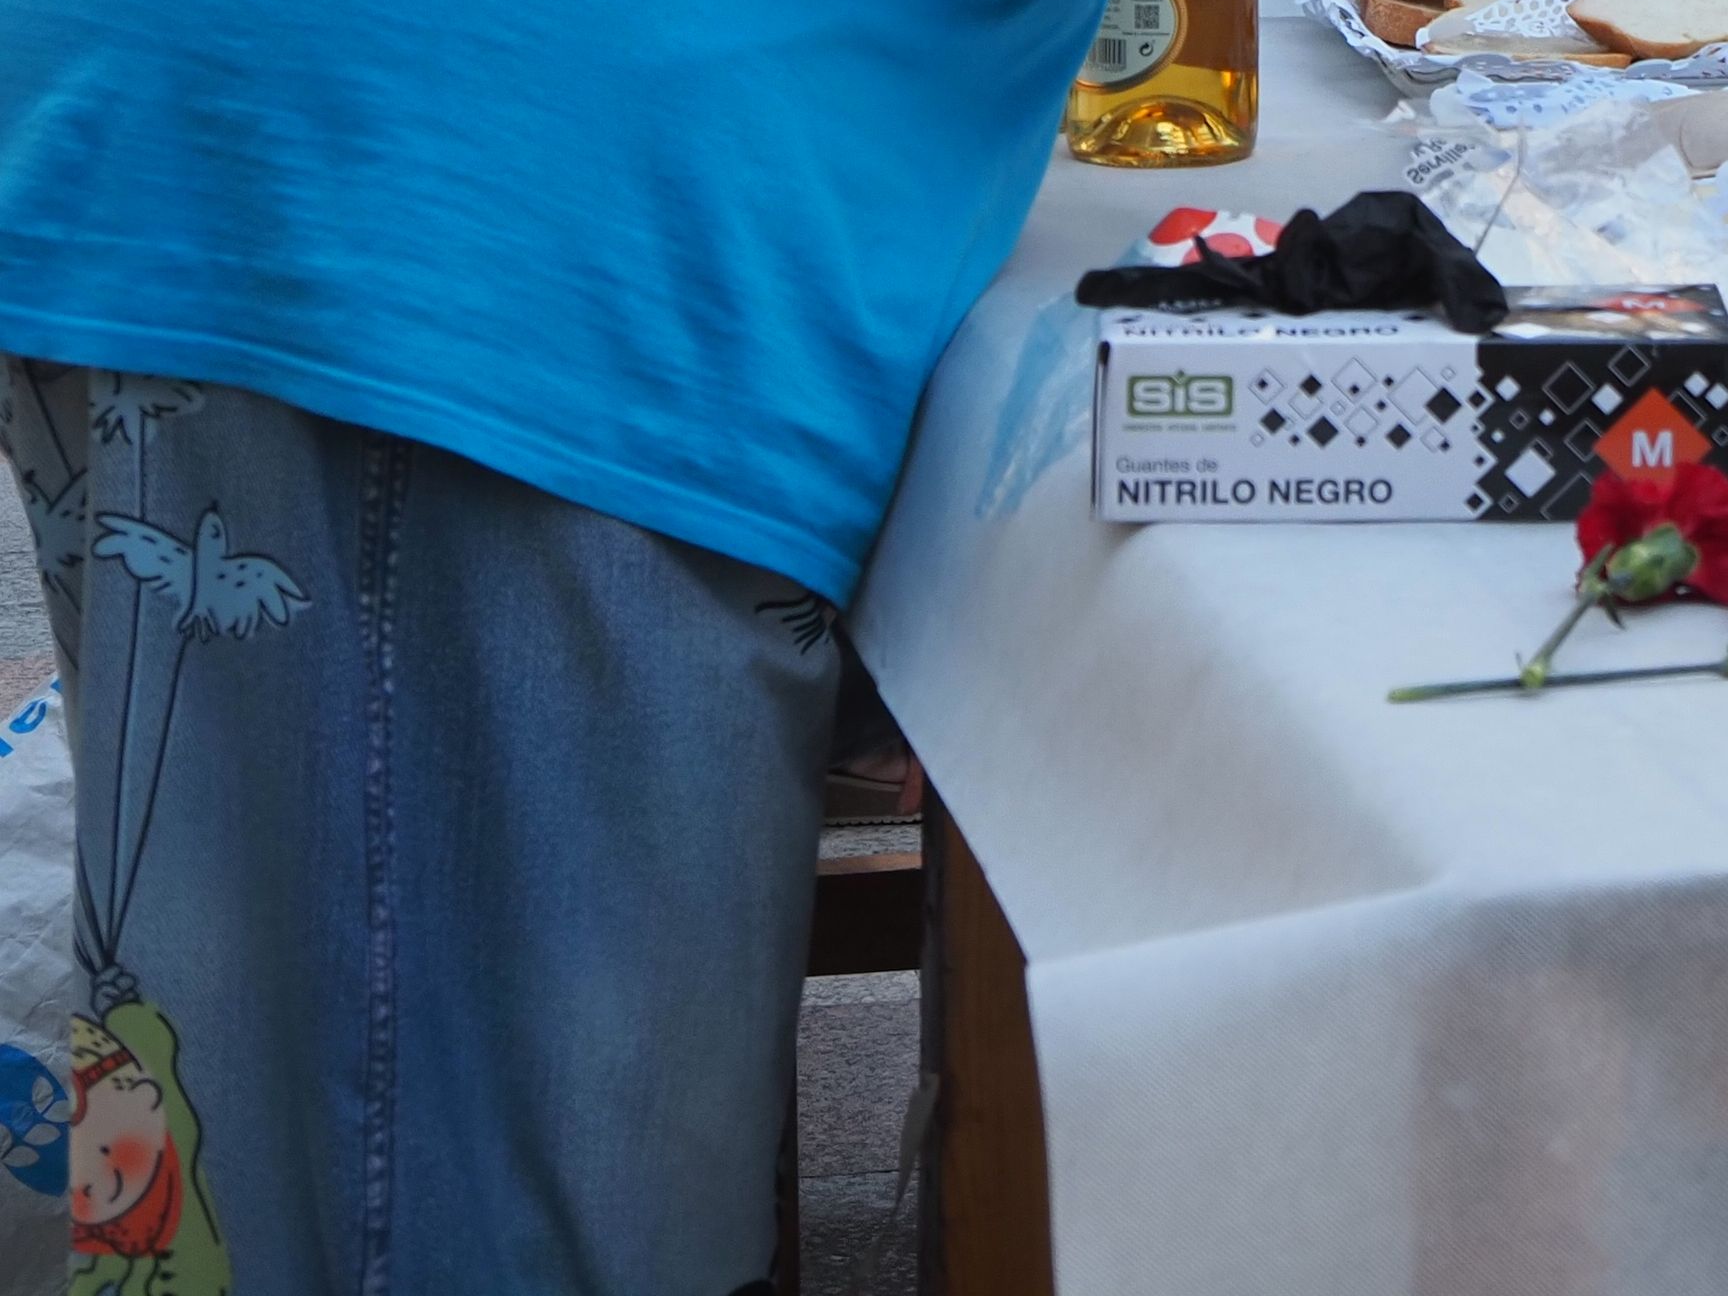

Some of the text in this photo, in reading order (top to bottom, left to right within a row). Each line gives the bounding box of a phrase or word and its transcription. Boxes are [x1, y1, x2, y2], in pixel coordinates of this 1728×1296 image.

[1632, 429, 1674, 469] M
[1115, 457, 1219, 474] Guantes de
[1117, 479, 1393, 506] NITRILO NEGRO
